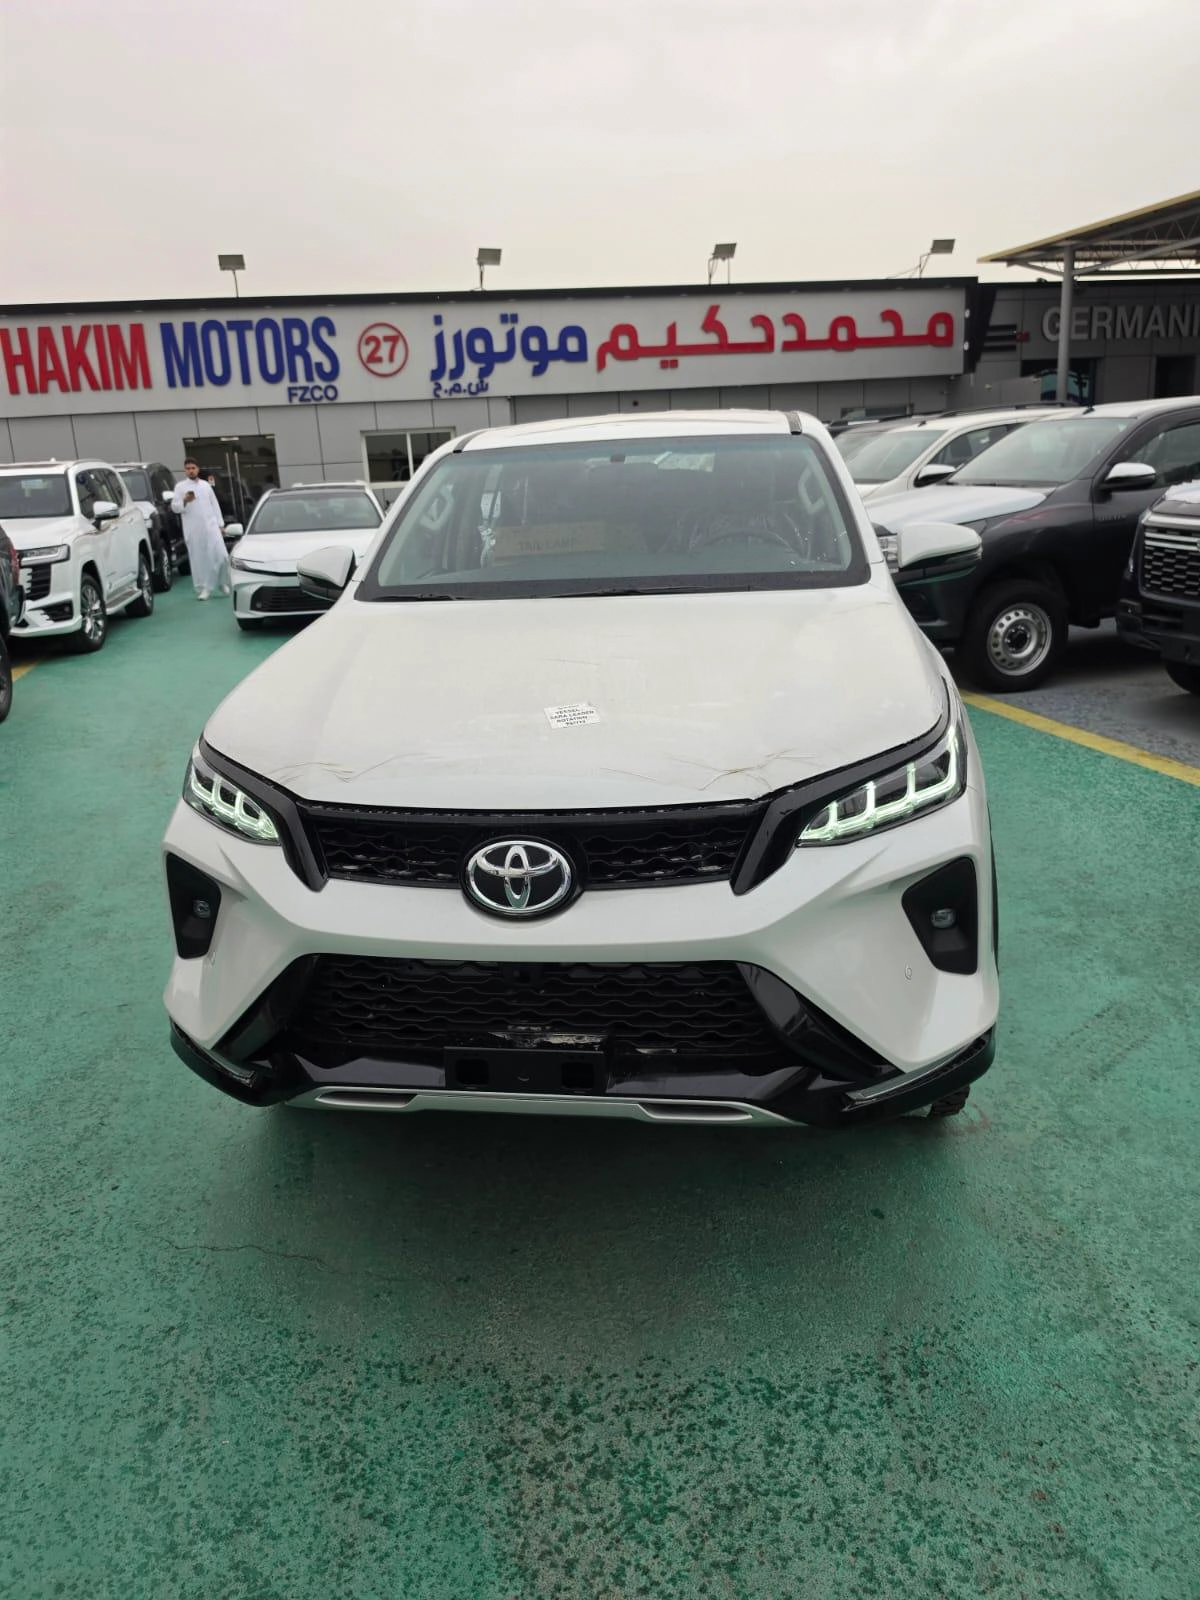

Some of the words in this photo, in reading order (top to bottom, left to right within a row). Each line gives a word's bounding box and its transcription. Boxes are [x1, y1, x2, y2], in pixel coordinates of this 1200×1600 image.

[0, 322, 153, 396] HAKIM
[159, 316, 341, 389] MOTORS
[363, 334, 401, 365] 27
[429, 312, 588, 382] موتورز
[596, 303, 775, 374] حكيم
[780, 308, 954, 353] محمد
[287, 384, 339, 404] FZCO
